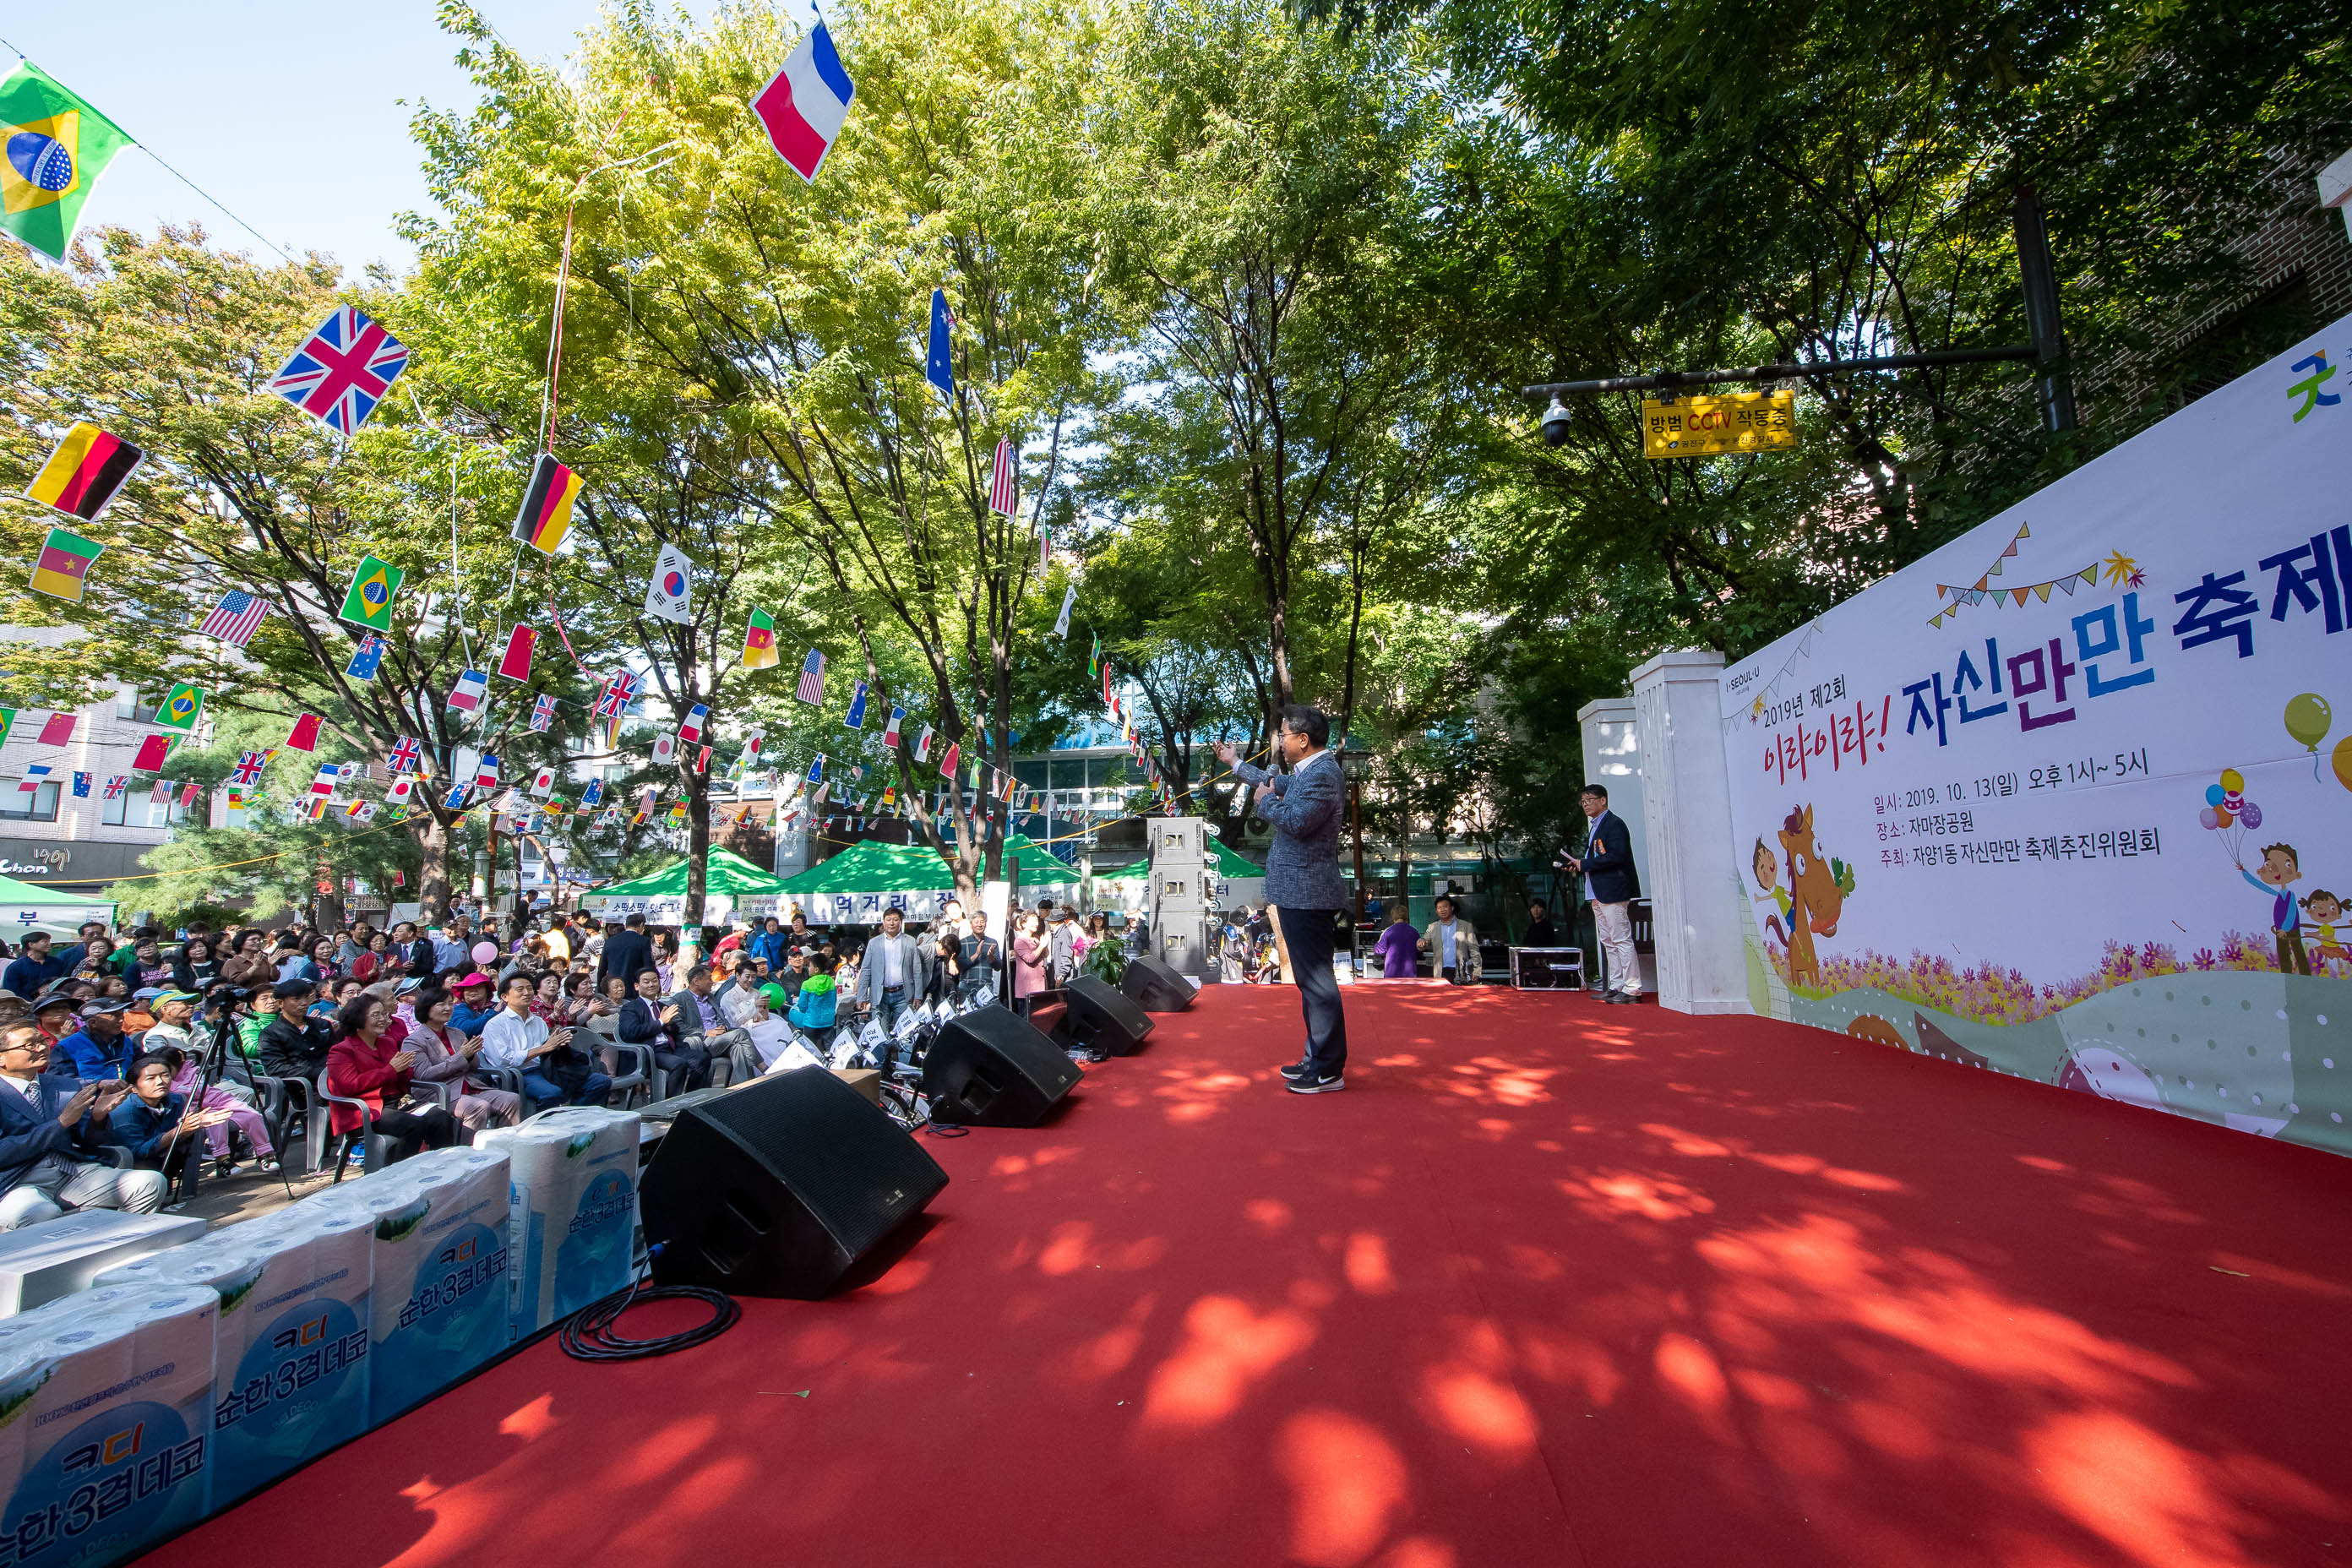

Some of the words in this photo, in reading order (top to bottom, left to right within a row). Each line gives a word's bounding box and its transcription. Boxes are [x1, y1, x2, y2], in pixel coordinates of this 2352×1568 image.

[1651, 415, 1682, 433] 방범
[1688, 411, 1731, 432] CCTV
[1736, 407, 1787, 427] 작동중
[1764, 694, 1891, 786] 이랴이랴!
[1902, 591, 2155, 748] 자신만만
[2172, 524, 2352, 659] 축제
[1763, 693, 1804, 728] 2019년
[1810, 673, 1847, 709] 제2회
[1874, 792, 1902, 814] 일시:
[1906, 787, 1940, 808] 2019.
[1946, 782, 1967, 802] 10.
[1974, 772, 2019, 798] 13(일)
[2028, 764, 2063, 790] 오후
[2115, 748, 2149, 776] 5시
[1876, 821, 1905, 841] 장소:
[1908, 809, 1974, 838] 자마장공원
[1881, 847, 1909, 868] 주최:
[1913, 843, 1957, 868] 자양1동
[1961, 838, 2020, 864] 자신만만
[2025, 826, 2161, 862] 축제추진위원회
[399, 1283, 440, 1331] 순한
[441, 1266, 474, 1305] 3겹
[475, 1247, 507, 1287] 데코
[215, 1372, 273, 1432] 순한
[274, 1349, 322, 1402] 3겹
[322, 1327, 369, 1378] 데코
[63, 1465, 135, 1537] 3겹
[135, 1433, 205, 1501] 데코
